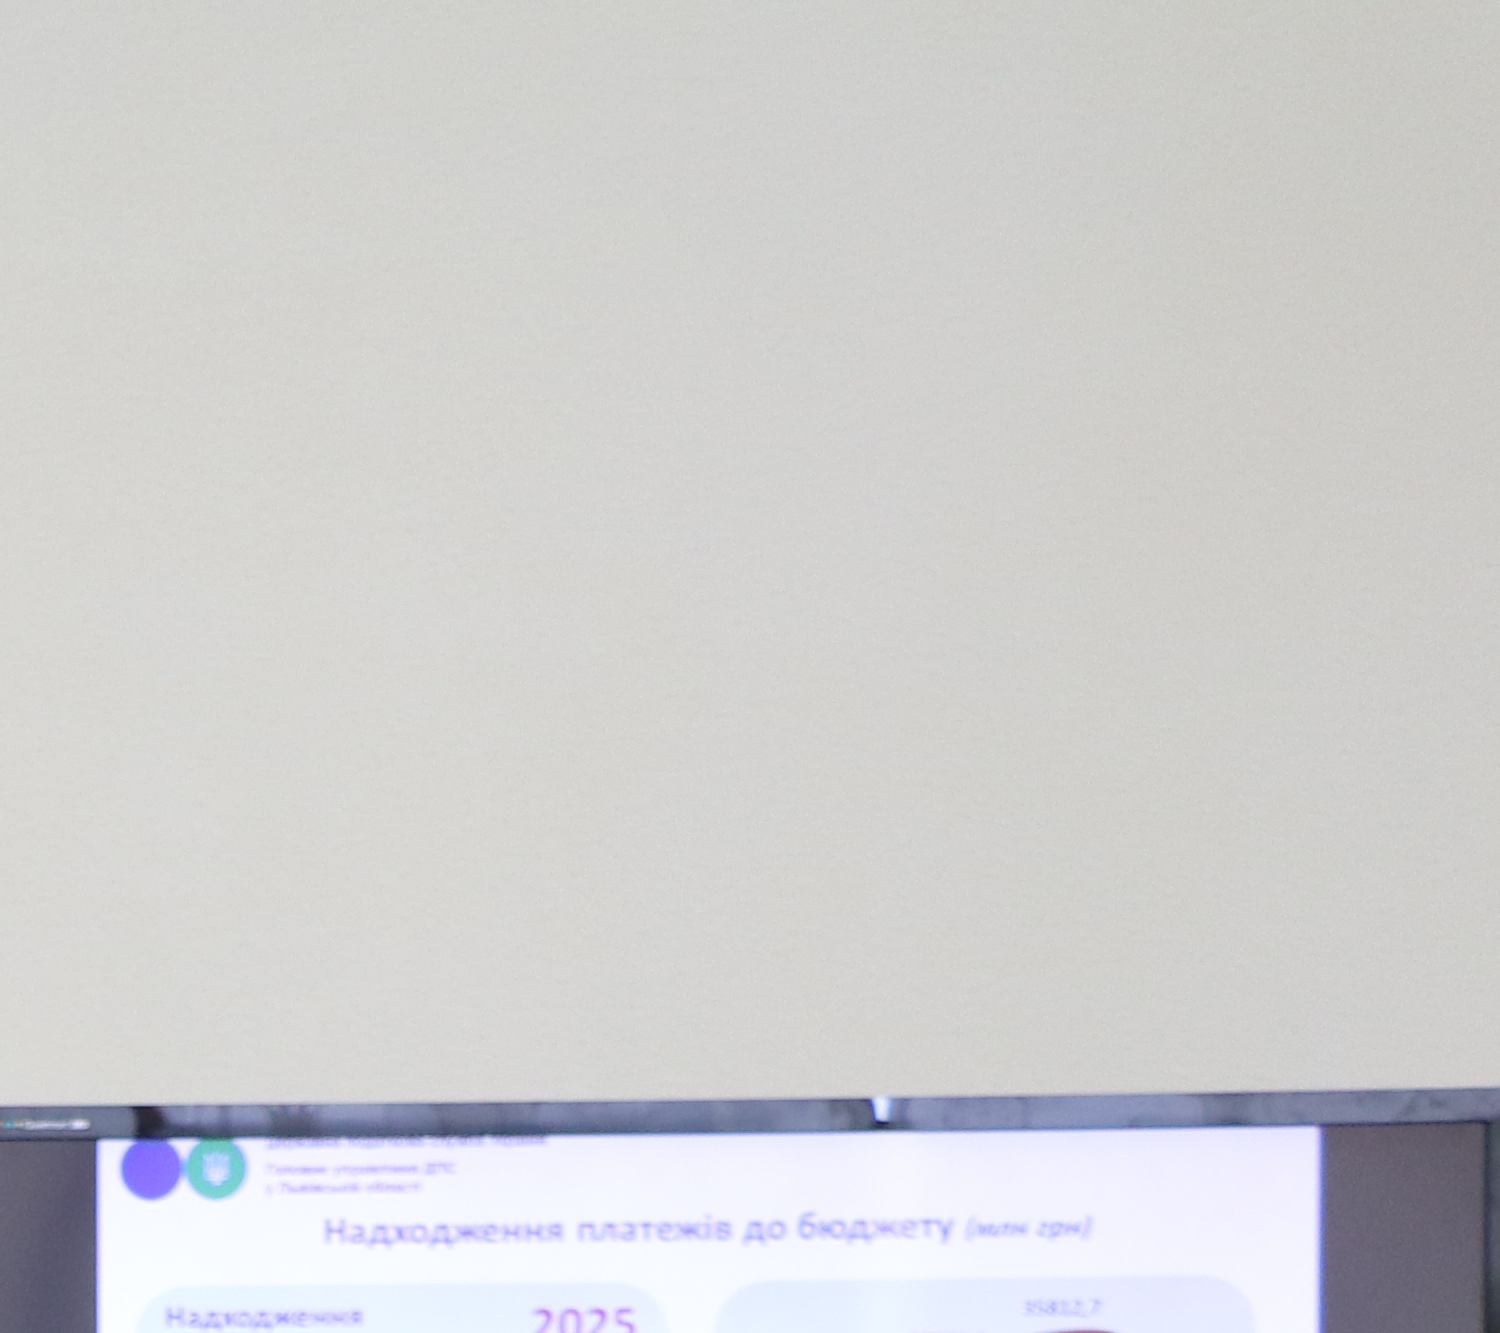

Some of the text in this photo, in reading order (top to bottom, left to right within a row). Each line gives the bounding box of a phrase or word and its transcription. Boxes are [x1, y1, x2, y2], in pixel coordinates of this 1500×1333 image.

[323, 1219, 564, 1247] Надходження
[576, 1213, 731, 1242] платежів
[741, 1220, 785, 1246] до
[798, 1212, 954, 1245] бюджету
[165, 1307, 364, 1330] Надходження
